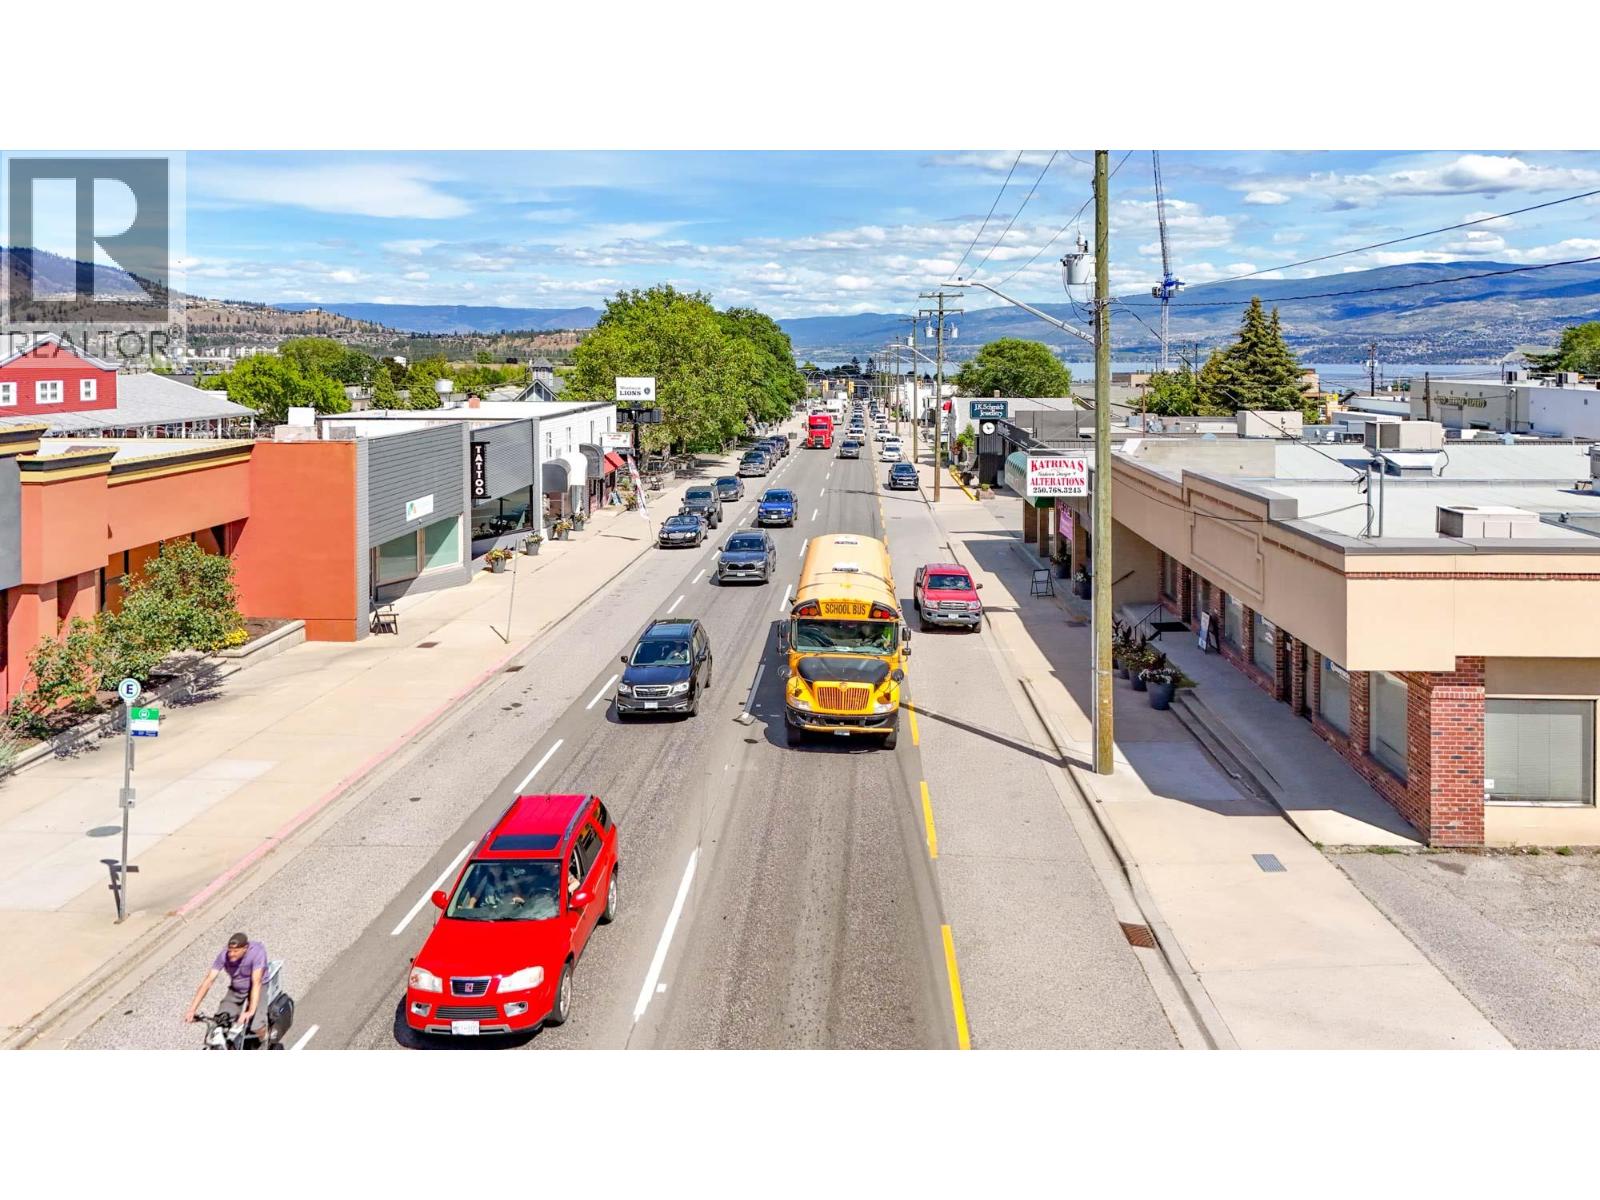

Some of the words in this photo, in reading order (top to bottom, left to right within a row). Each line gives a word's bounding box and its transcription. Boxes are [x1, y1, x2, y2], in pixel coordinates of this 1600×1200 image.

[475, 446, 484, 495] TATTOO
[1031, 460, 1084, 472] KATRINAS
[1031, 477, 1085, 486] ALTERATIONS
[825, 603, 850, 614] SCHOOL
[852, 604, 866, 615] BUS
[126, 684, 134, 695] E
